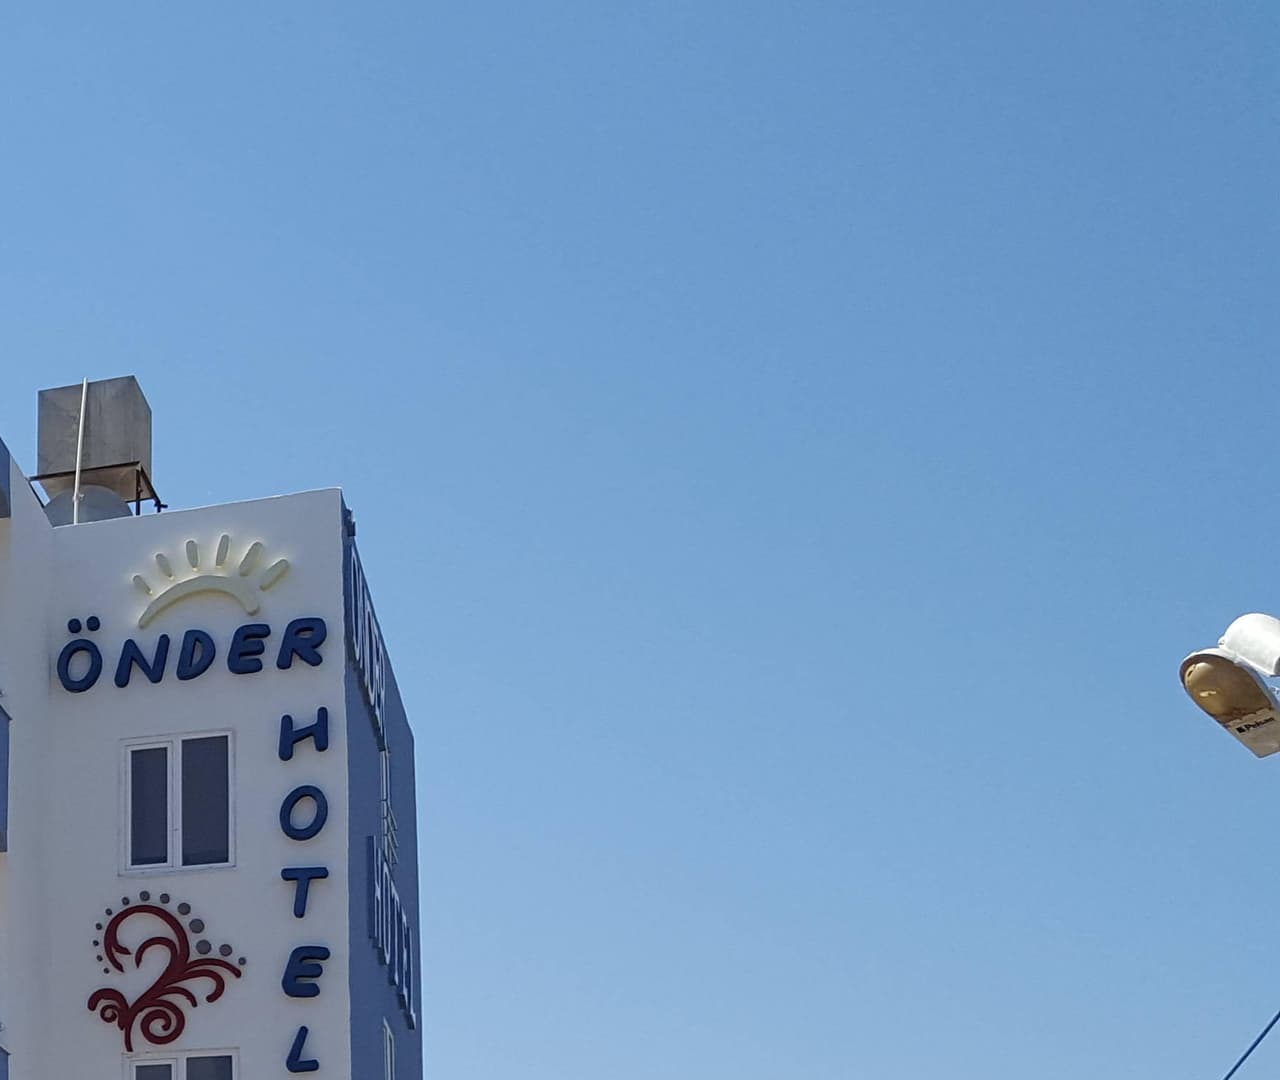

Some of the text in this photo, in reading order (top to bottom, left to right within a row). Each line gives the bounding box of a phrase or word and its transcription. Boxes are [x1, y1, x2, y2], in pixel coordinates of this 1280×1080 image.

[57, 616, 327, 693] ÖNDER
[278, 706, 331, 1073] HOTEL
[372, 835, 416, 1029] HOTEL
